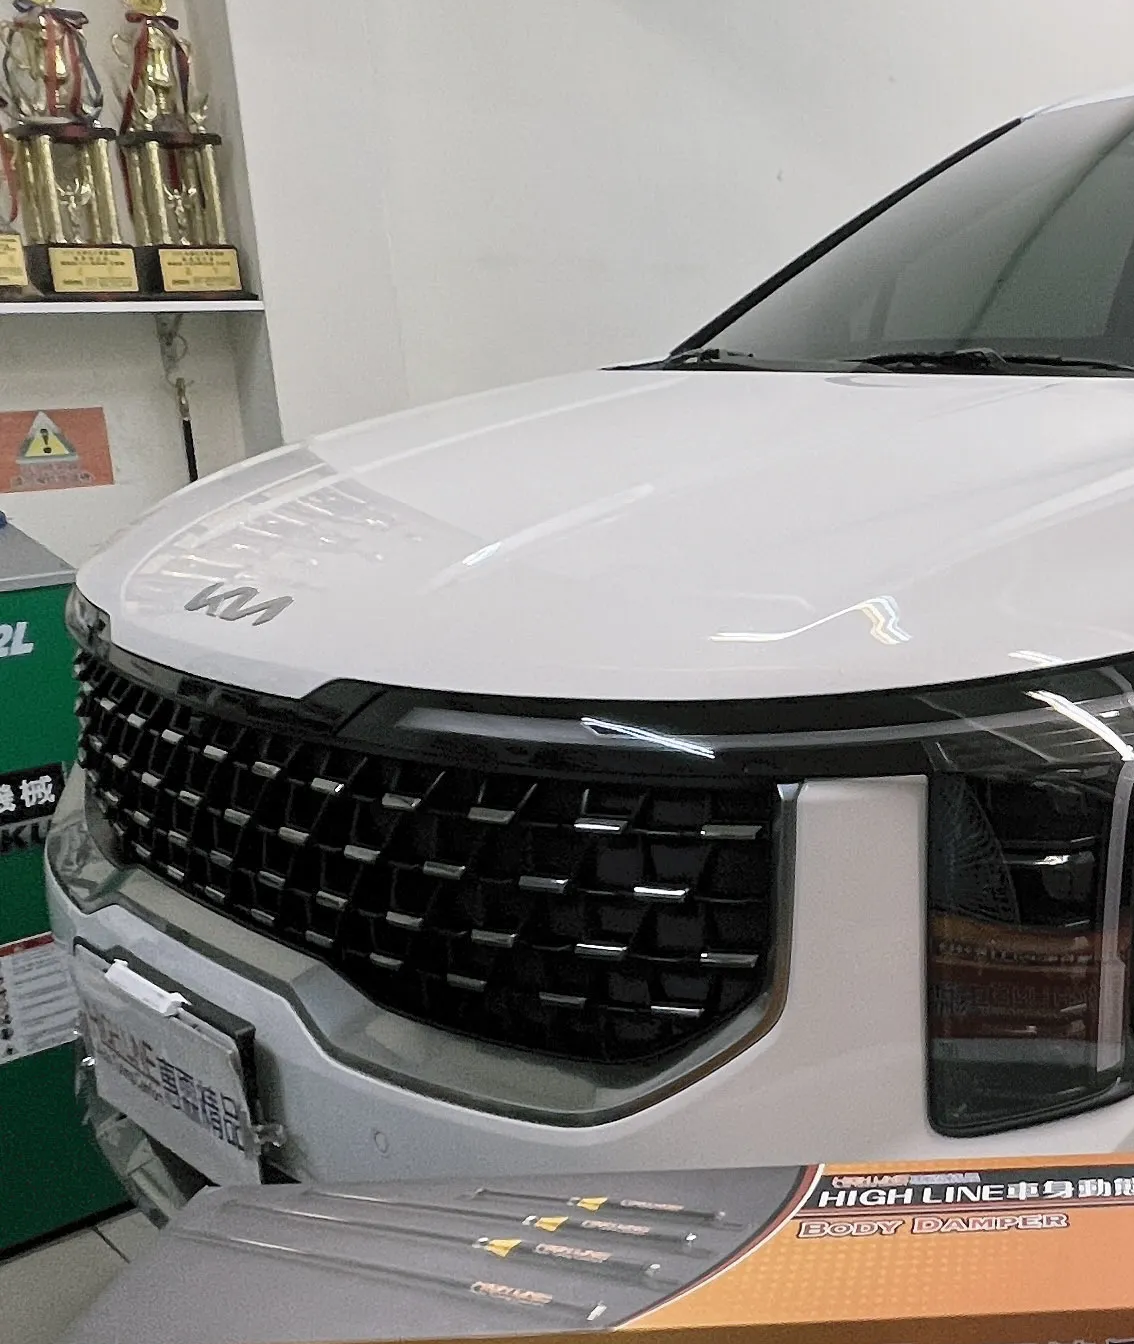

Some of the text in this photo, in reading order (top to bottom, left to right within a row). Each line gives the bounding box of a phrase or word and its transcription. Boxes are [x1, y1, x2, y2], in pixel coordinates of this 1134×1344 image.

[818, 1188, 913, 1208] HIGH
[797, 1213, 1069, 1238] BODY DAMPER
